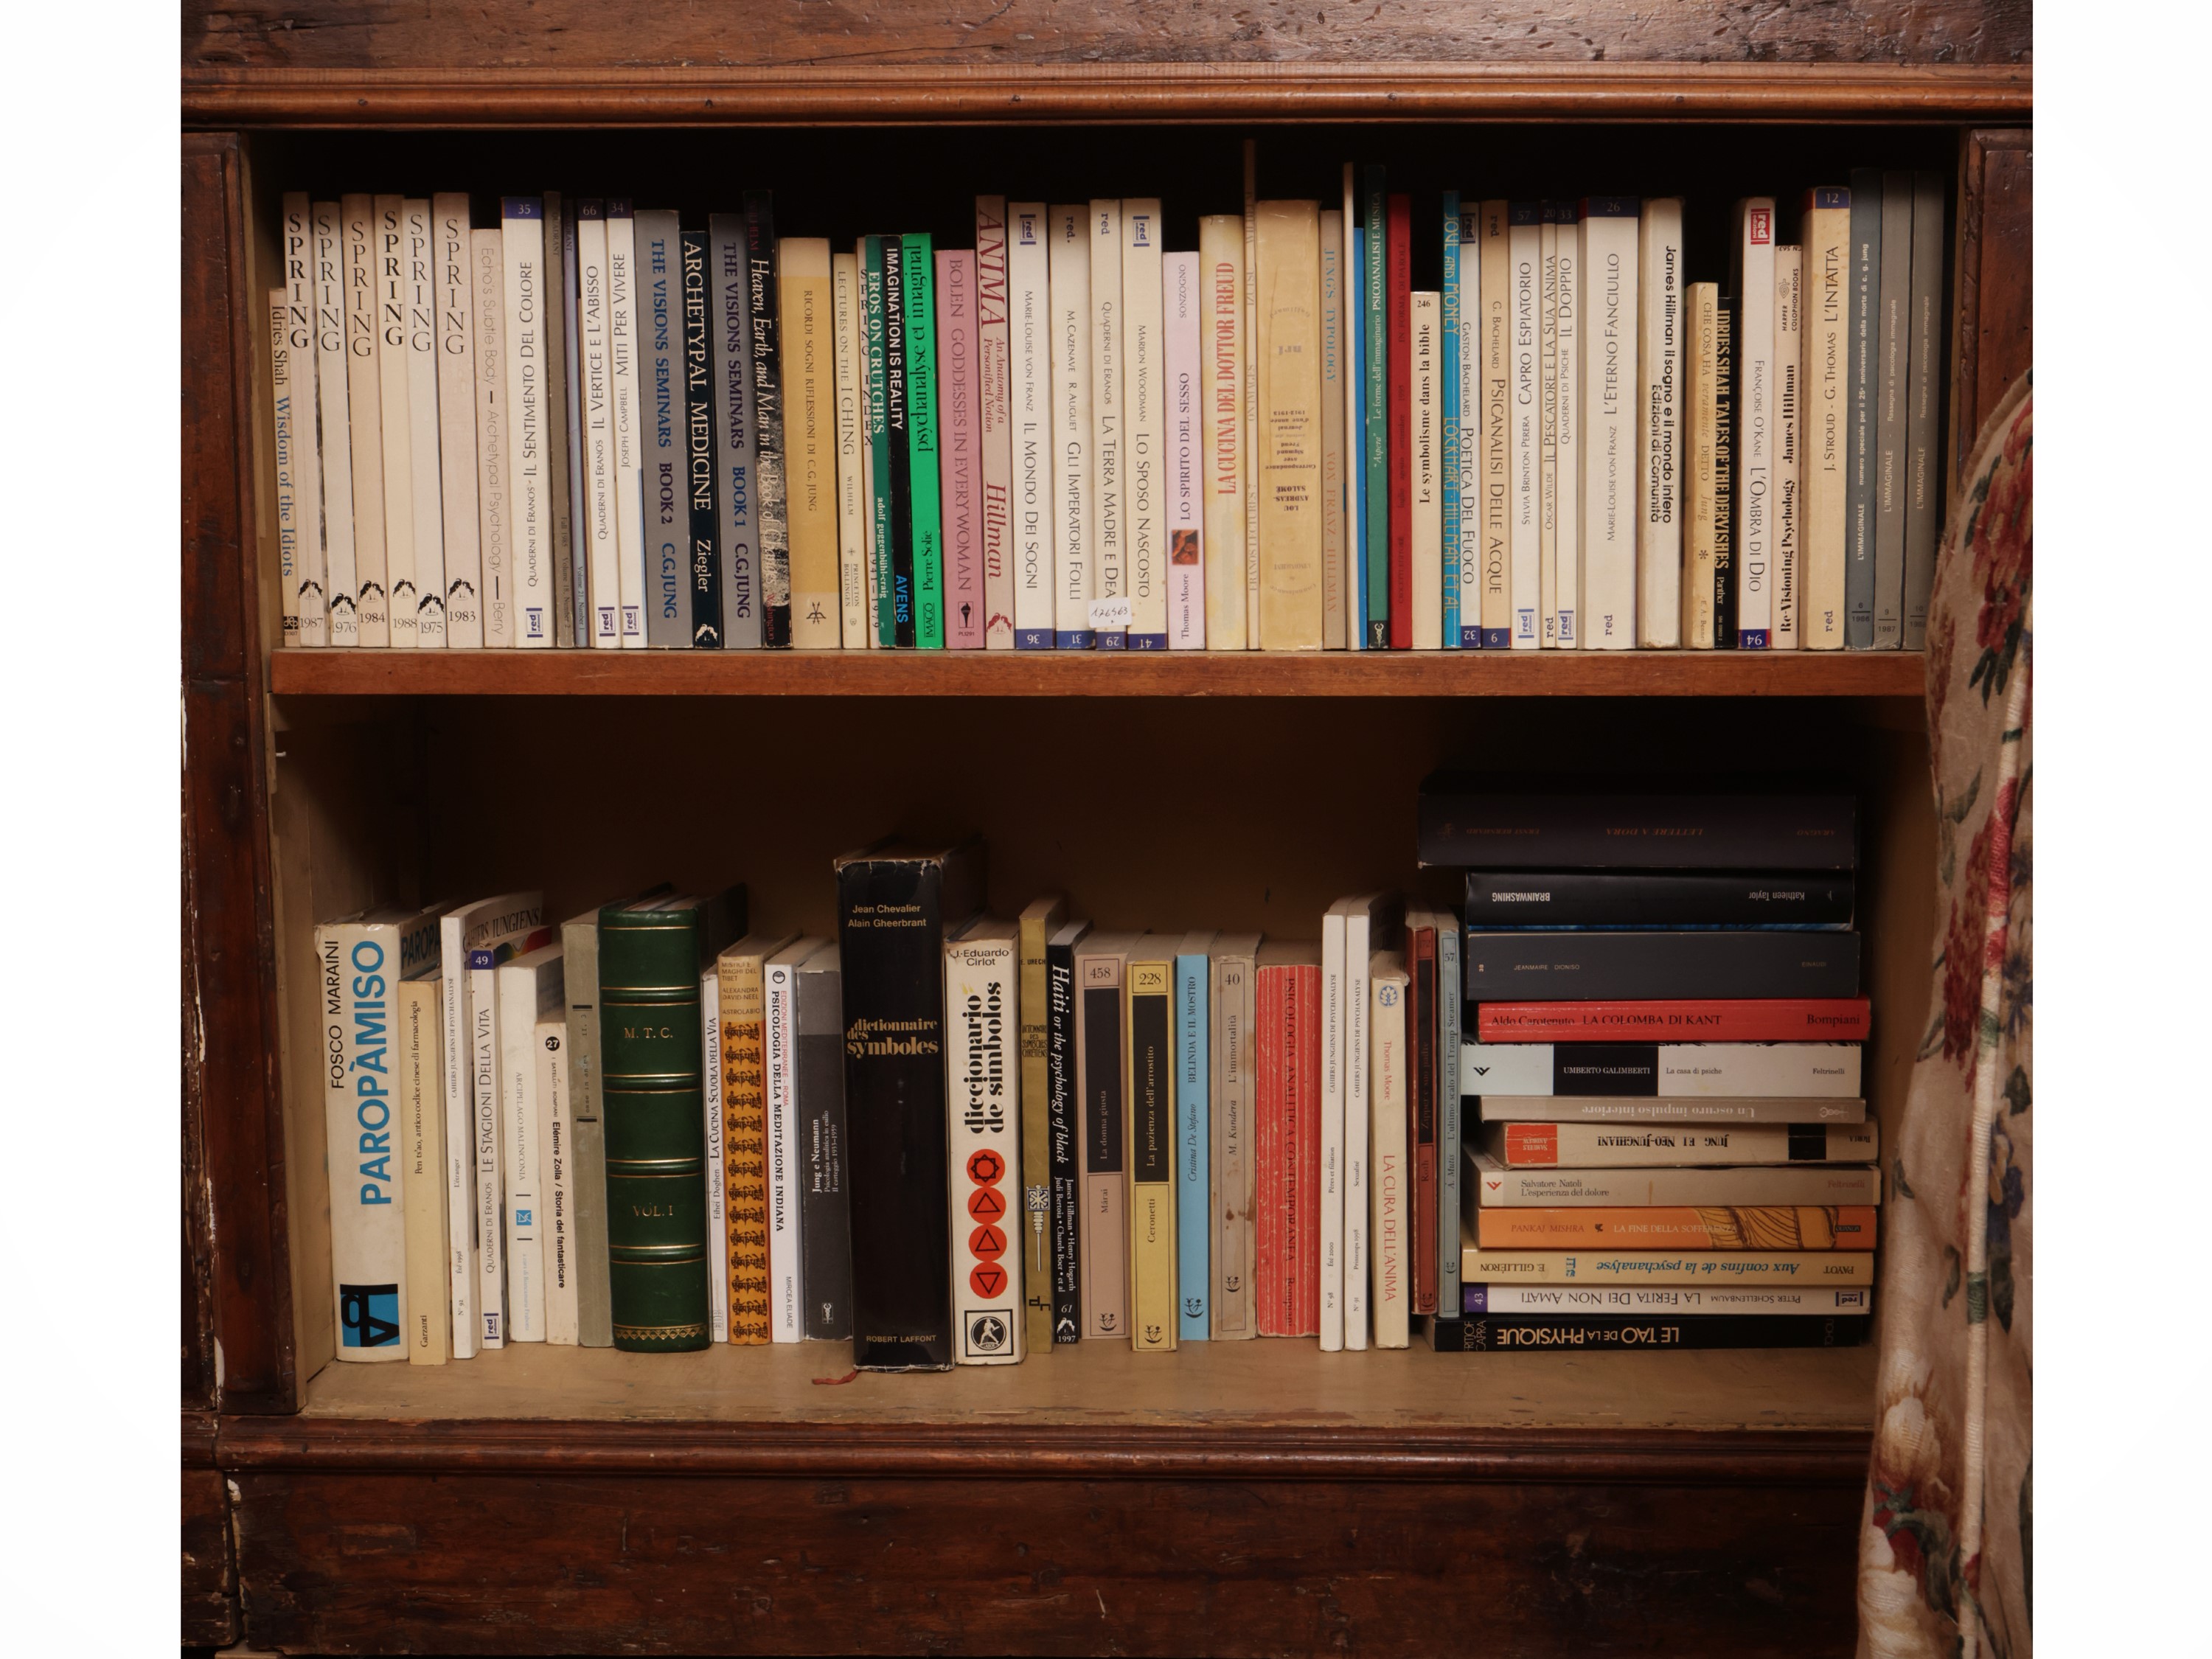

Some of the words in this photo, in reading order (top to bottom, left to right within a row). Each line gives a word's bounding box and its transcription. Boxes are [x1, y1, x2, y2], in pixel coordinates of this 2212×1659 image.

[518, 204, 532, 215] 35
[1826, 192, 1839, 204] 12
[289, 213, 309, 348] SPRING
[319, 215, 339, 351] SPRING
[352, 221, 372, 357] SPRING
[385, 211, 403, 346] SPRING
[411, 215, 431, 352] SPRING
[445, 219, 464, 355] SPRING
[481, 248, 494, 294] Echo's
[519, 262, 533, 323] COLORE
[613, 254, 626, 305] VIVERE
[751, 258, 769, 315] Heaven,
[869, 271, 882, 318] EROS
[905, 245, 927, 319] imaginal
[949, 260, 963, 319] BOLEN
[977, 209, 1006, 329] ANIMA
[1216, 262, 1236, 315] FREUD
[1371, 241, 1382, 311] PSICOANALISI
[1559, 259, 1572, 319] DOPPIO
[1666, 246, 1677, 291] James
[1823, 246, 1839, 322] L'INTATTA
[483, 299, 496, 345] Subtle
[586, 265, 601, 332] L'ABISSO
[653, 279, 669, 351] VISIONS
[685, 240, 707, 392] ARCHETYPAL
[724, 282, 740, 352] VISIONS
[804, 291, 814, 335] RICORDI
[838, 271, 849, 333] LECTURES
[886, 248, 902, 349] IMAGINATION
[1417, 301, 1431, 313] 246
[1518, 262, 1531, 347] ESPIATORIO
[1604, 254, 1619, 337] FANCIULLO
[1665, 295, 1676, 345] Hillman
[273, 306, 286, 345] Idries
[521, 329, 534, 357] DEL
[1217, 319, 1236, 385] DOTTOR
[1419, 323, 1430, 358] bible
[1717, 310, 1730, 355] IDRIES
[274, 349, 287, 386] Shah
[590, 352, 604, 411] VERTICE
[615, 343, 628, 376] MITI
[951, 327, 967, 427] GODDESSES
[1518, 352, 1531, 406] CAPRO
[1824, 333, 1836, 384] THOMAS
[523, 365, 537, 459] SENTIMENTO
[619, 386, 629, 432] CAMPBELL
[655, 358, 672, 448] SEMINARS
[727, 360, 744, 450] SEMINARS
[805, 378, 816, 440] RIFLESSIONI
[871, 349, 885, 434] CRUTCHES
[889, 373, 903, 431] REALITY
[909, 344, 933, 453] psychanalyse
[1180, 372, 1191, 414] SESSO
[276, 396, 291, 465] Wisdom
[487, 410, 501, 487] Archetypal
[621, 436, 630, 468] JOSEPH
[841, 397, 855, 456] CHING
[1217, 417, 1237, 472] CUCINA
[1419, 409, 1433, 484] symbolisme
[1490, 379, 1506, 474] PSICANALISI
[690, 402, 712, 511] MEDICINE
[1024, 440, 1037, 505] MONDO
[1103, 439, 1116, 487] TERRA
[1180, 445, 1191, 499] SPIRITO
[1461, 428, 1475, 495] POETICA
[1663, 429, 1673, 480] mondo
[658, 462, 673, 514] BOOK
[1136, 460, 1150, 509] SPOSO
[1662, 484, 1673, 524] infero
[1749, 467, 1766, 536] L'OMBRA
[488, 492, 503, 573] Psychology
[953, 457, 972, 591] EVERYWOMAN
[986, 483, 1007, 580] Hillman
[1068, 473, 1082, 554] IMPERATORI
[1714, 494, 1730, 569] DERVISHES
[1782, 479, 1795, 546] Psychology
[1857, 503, 1865, 561] L'IMMAGINALE
[282, 528, 295, 577] Idiots
[527, 538, 538, 587] QUADERNI
[696, 540, 712, 592] Ziegler
[877, 524, 887, 599] guggenbühl-craig
[1137, 518, 1151, 598] NASCOSTO
[1461, 531, 1475, 584] FUOCO
[1486, 536, 1505, 594] ACQUE
[895, 574, 908, 624] AVENS
[1069, 561, 1083, 600] FOLLI
[1781, 550, 1795, 632] Re-Visioning
[300, 617, 322, 628] 1987
[360, 613, 386, 624] 1984
[449, 611, 476, 622] 1983
[1181, 605, 1190, 639] Thomas
[852, 905, 874, 914] Jean
[877, 904, 921, 914] Chevalier
[1492, 892, 1551, 902] BRAINWASHING
[1771, 891, 1805, 900] Kathleen
[493, 908, 540, 950] JUNGIENS
[848, 918, 871, 928] Alain
[873, 917, 927, 928] Gheerbrant
[324, 941, 341, 1015] MARAINI
[963, 948, 1009, 958] Eduardo
[966, 958, 995, 967] Cirlot
[1090, 967, 1111, 978] 458
[1139, 973, 1162, 984] 228
[722, 1009, 761, 1017] ASTROLABIO
[1052, 964, 1070, 1018] Haiti
[1188, 976, 1197, 1016] MOSTRO
[410, 1001, 422, 1053] farmacologia
[478, 1009, 491, 1038] VITA
[772, 991, 781, 1060] PSICOLOGIA
[854, 1018, 938, 1032] dictionnaire
[982, 981, 1004, 1096] simbolos
[1518, 1016, 1576, 1026] Carotenuto
[1601, 1015, 1664, 1026] COLOMBA
[1686, 1015, 1723, 1026] KANT
[1806, 1014, 1861, 1027] Bompiani
[329, 1025, 345, 1089] FOSCO
[349, 941, 392, 1206] PAROPÀMISO
[846, 1037, 939, 1060] symboles
[962, 995, 985, 1134] diccionario
[1187, 1041, 1196, 1083] BELINDA
[1563, 1067, 1601, 1075] UMBERTO
[1603, 1066, 1651, 1075] GALIMBERTI
[1051, 1053, 1068, 1115] psychology
[1147, 1046, 1155, 1106] dell'arrostito
[479, 1090, 495, 1155] STAGIONI
[552, 1122, 562, 1156] Elémire
[709, 1106, 720, 1143] CUCINA
[774, 1105, 783, 1182] MEDITAZIONE
[811, 1119, 820, 1161] Neumann
[1147, 1108, 1157, 1152] pazienza
[1227, 1099, 1237, 1140] Kundera
[555, 1192, 564, 1218] Storia
[776, 1186, 784, 1231] INDIANA
[1520, 1188, 1570, 1199] L'esperienza
[1521, 1180, 1557, 1188] Salvatore
[633, 1205, 665, 1217] VOL.
[1147, 1198, 1156, 1243] Ceronetti
[557, 1236, 566, 1289] fantasticare
[1383, 1220, 1397, 1301] DELL'ANIMA
[1823, 1265, 1854, 1275] PAYOT
[1520, 1293, 1562, 1304] AMATI
[1711, 1295, 1772, 1304] SCHELLENBAUM
[420, 1315, 428, 1348] Garzanti
[866, 1335, 898, 1343] ROBERT
[900, 1335, 937, 1343] LAFFONT
[1496, 1328, 1585, 1346] PHYSIQUE
